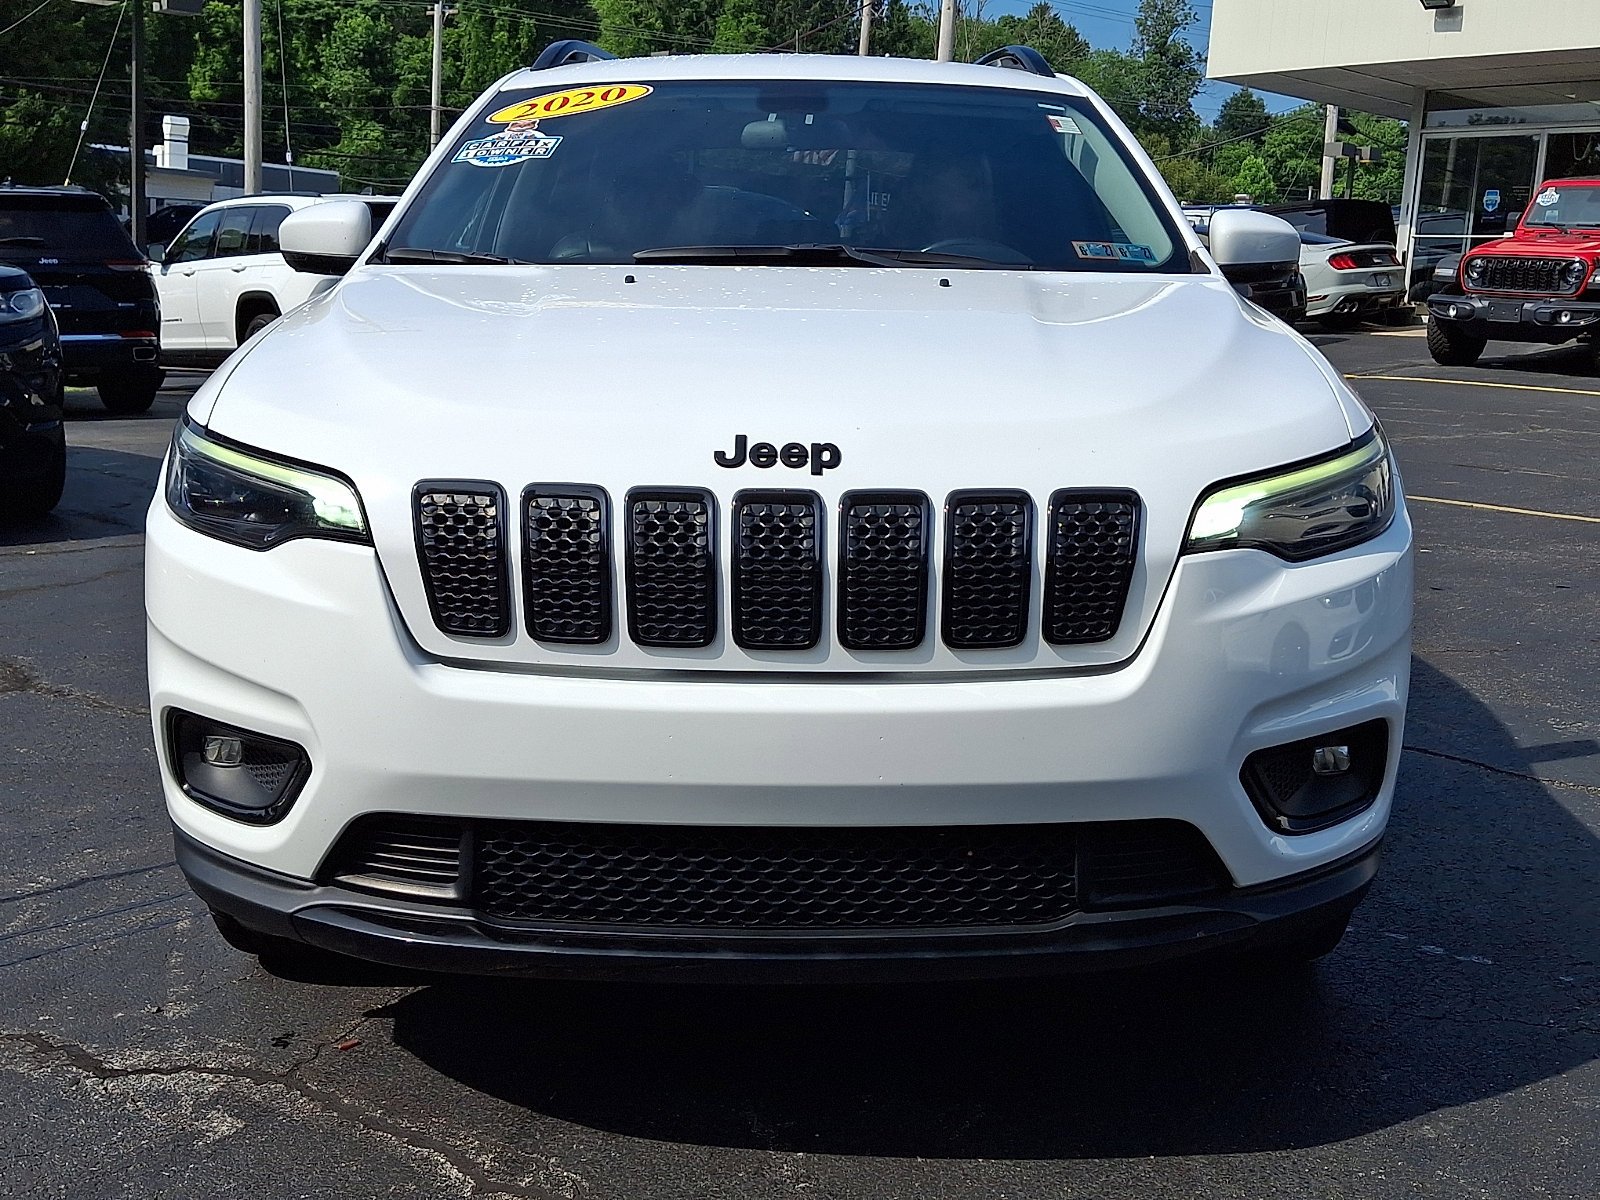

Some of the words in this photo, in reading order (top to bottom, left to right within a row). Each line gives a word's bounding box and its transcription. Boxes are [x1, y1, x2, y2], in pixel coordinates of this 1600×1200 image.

[513, 87, 627, 119] 2020
[467, 140, 552, 150] CARFAX
[475, 148, 548, 157] OWNER
[38, 257, 59, 265] Jeep
[713, 434, 843, 476] Jeep
